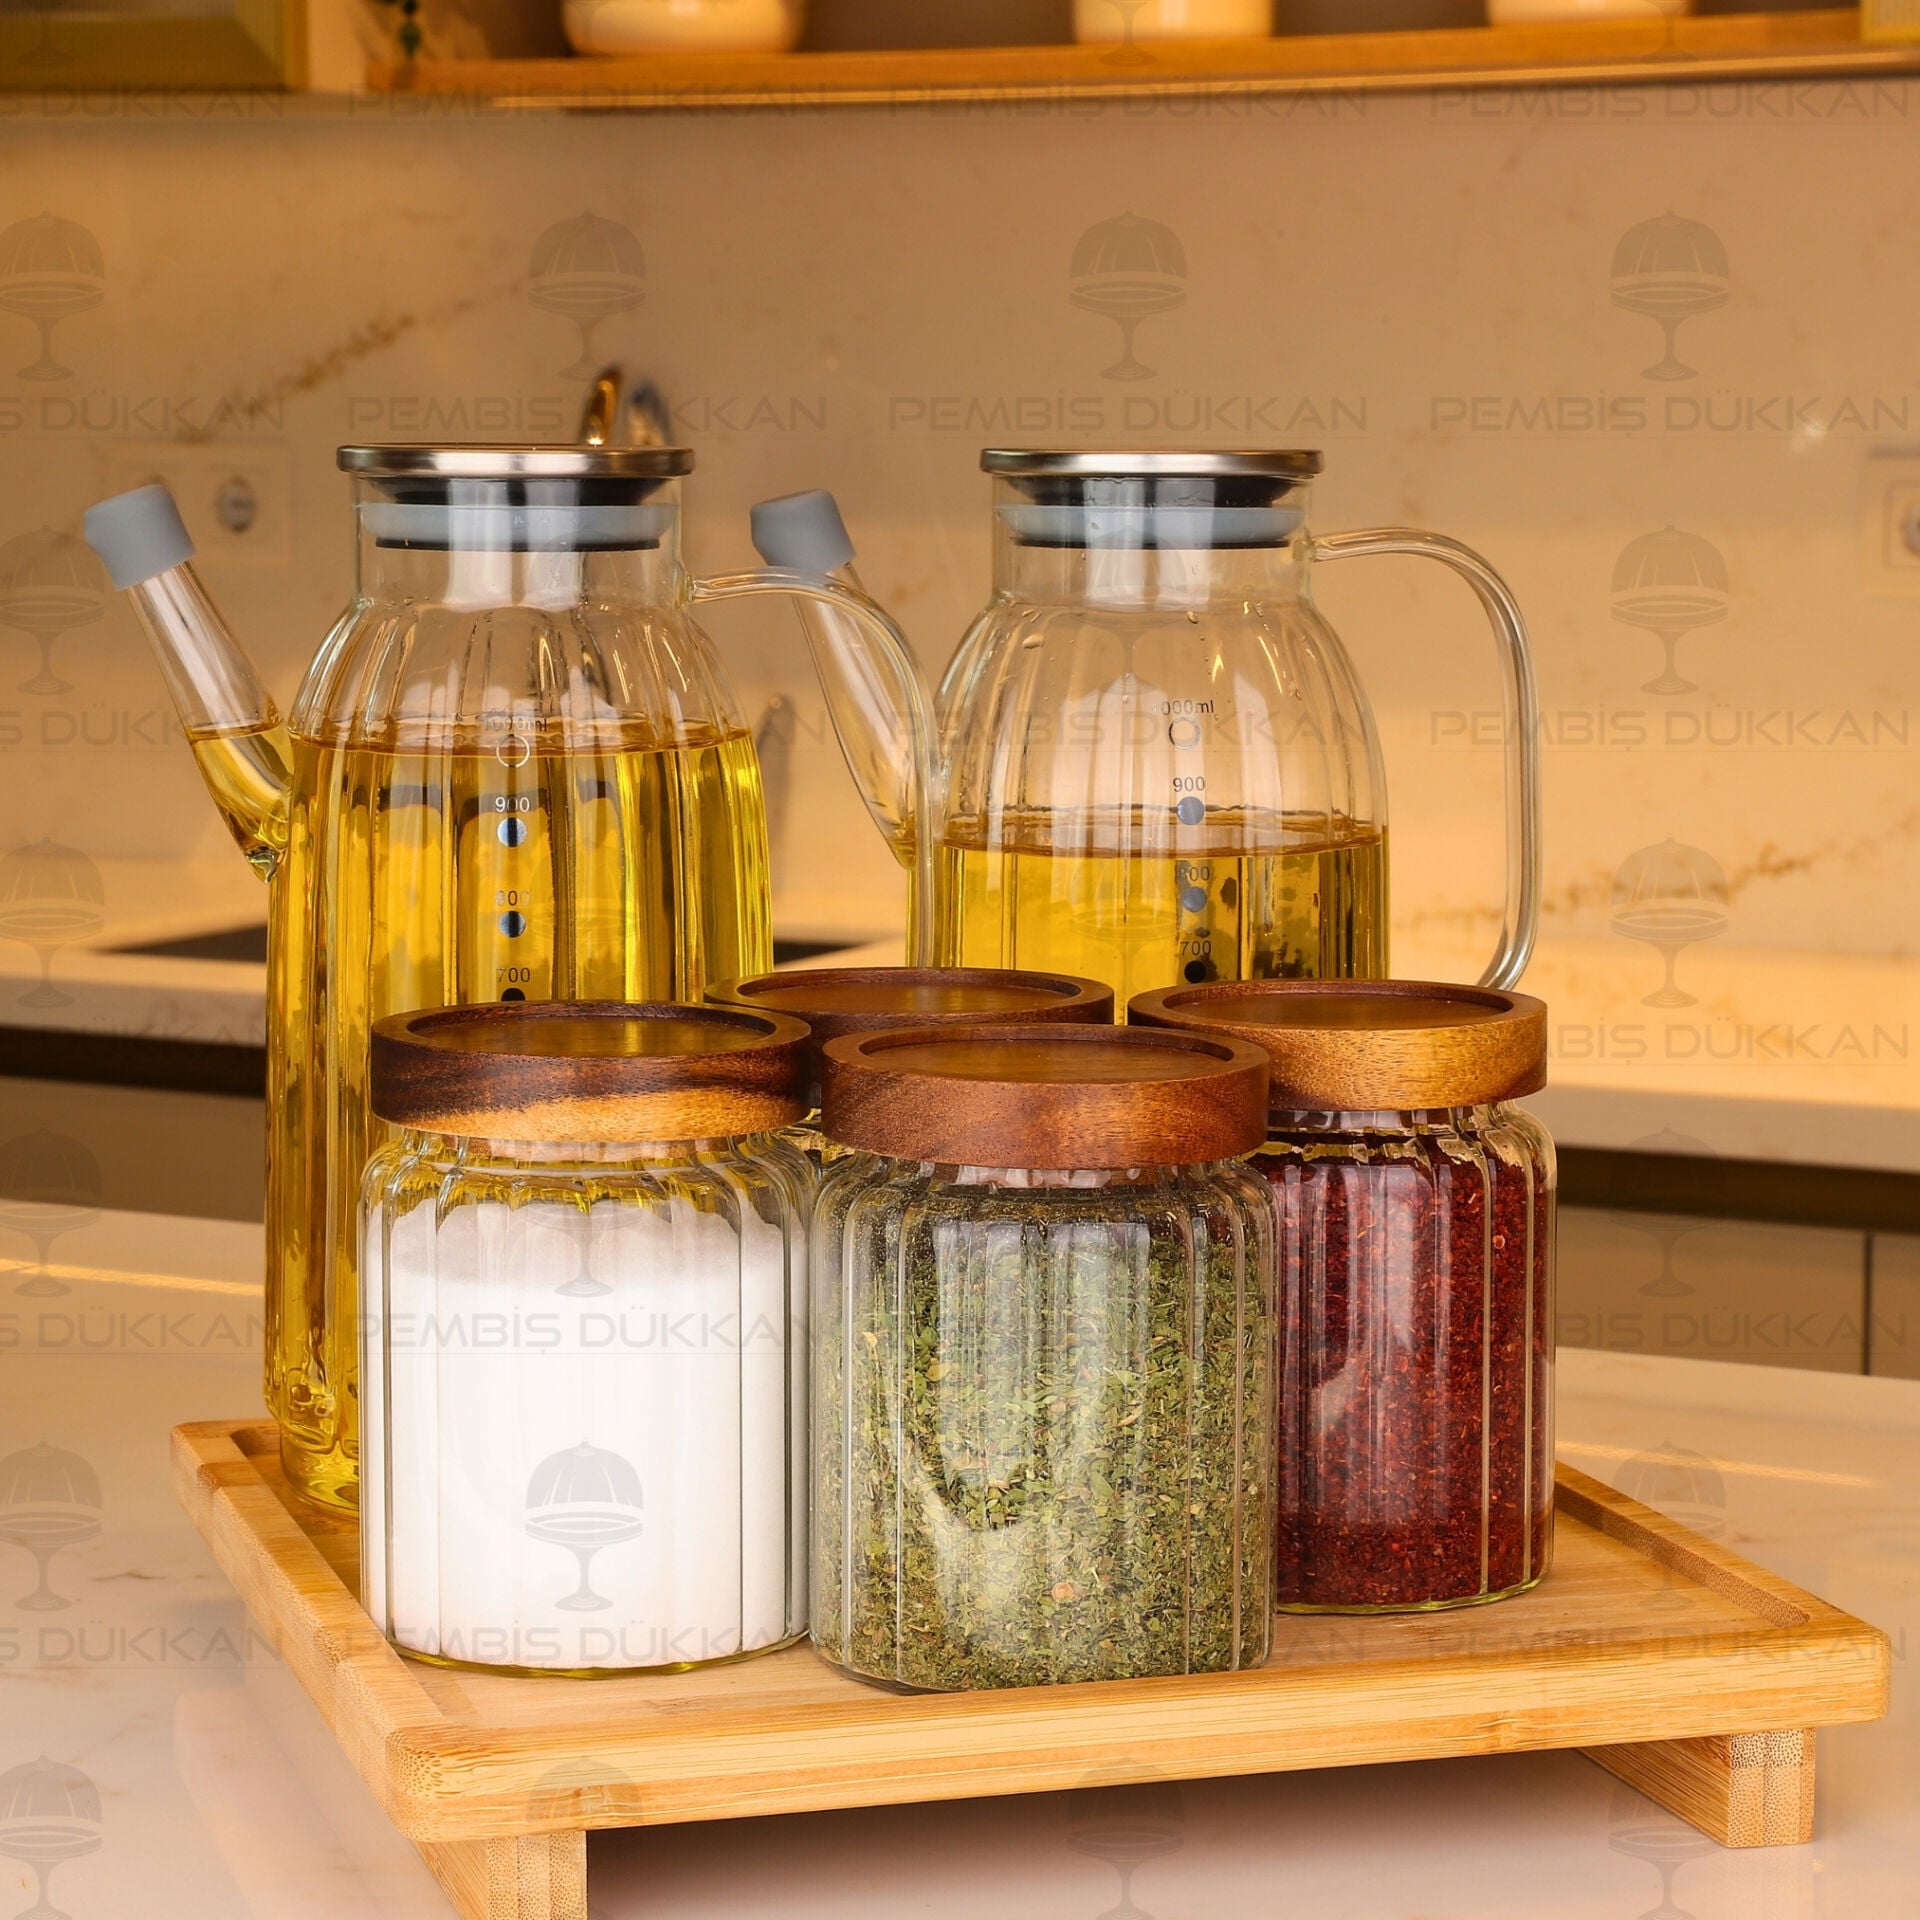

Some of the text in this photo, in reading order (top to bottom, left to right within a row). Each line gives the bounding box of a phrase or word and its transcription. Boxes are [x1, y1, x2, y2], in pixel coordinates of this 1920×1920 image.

[1173, 776, 1206, 792] 900
[495, 796, 530, 812] 900
[1180, 940, 1212, 957] 700
[497, 967, 531, 983] 700
